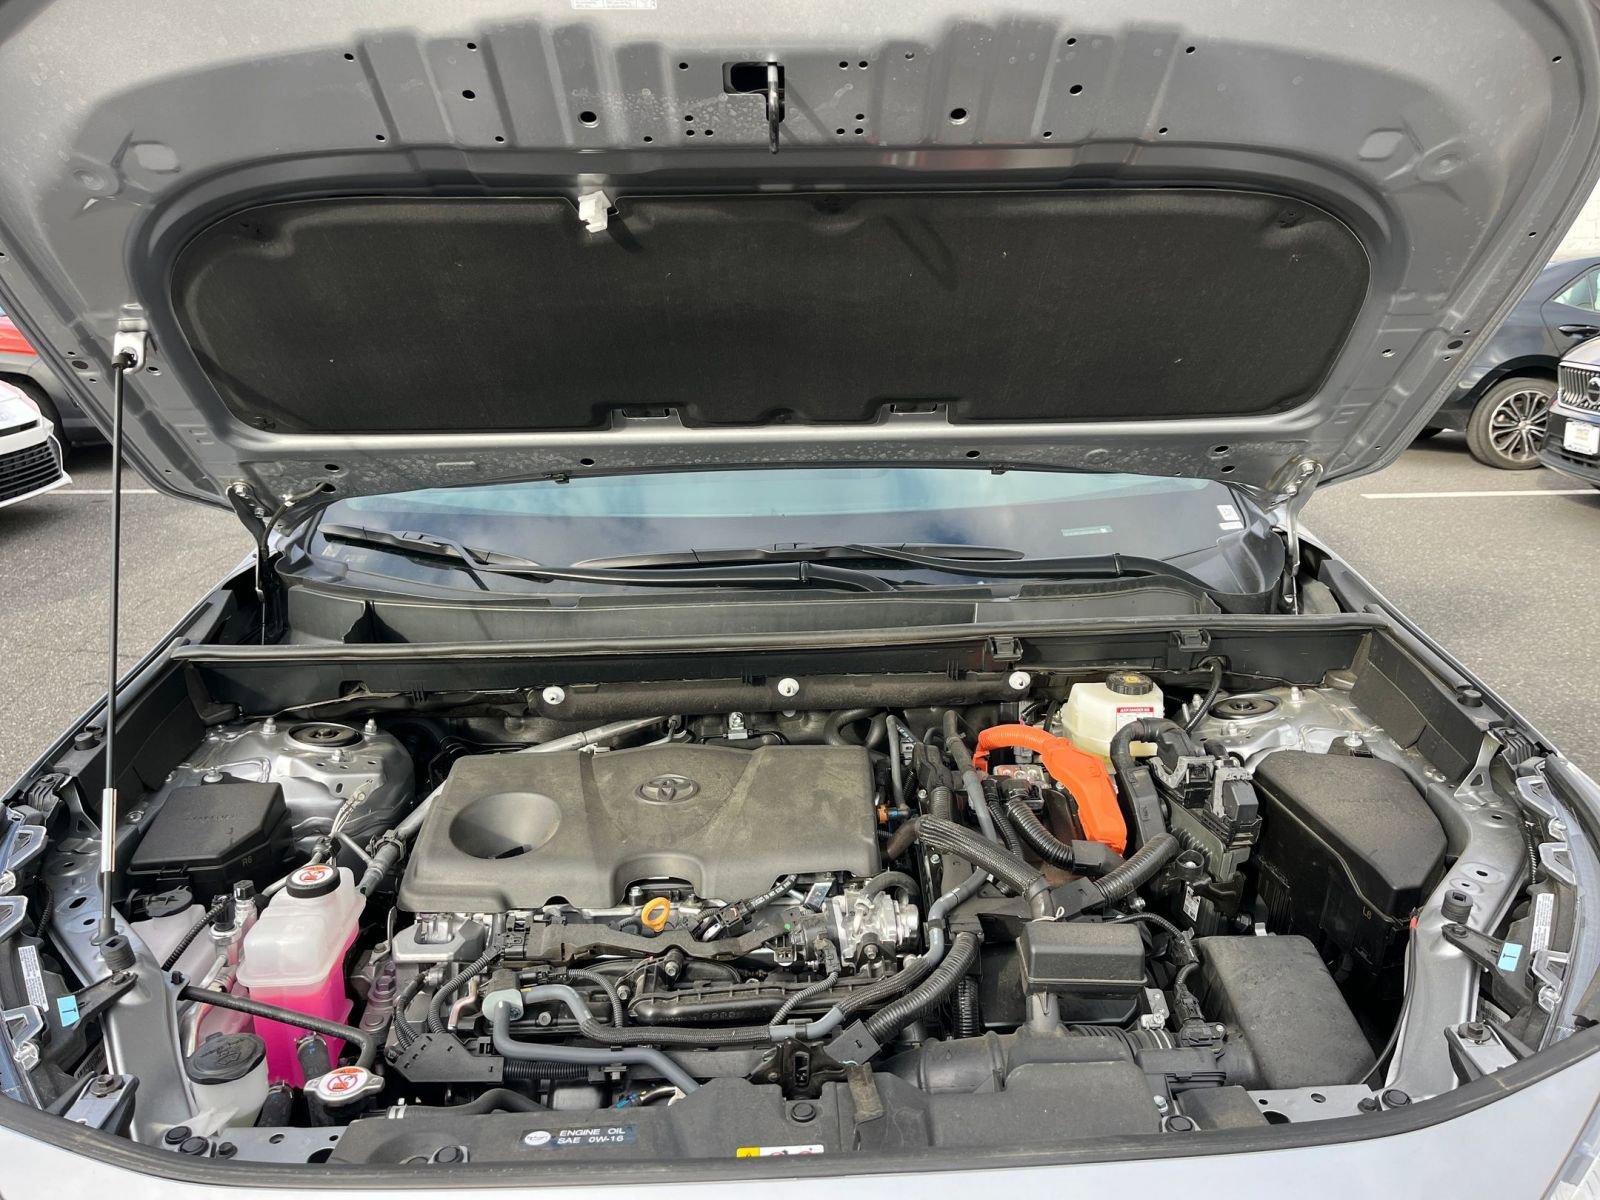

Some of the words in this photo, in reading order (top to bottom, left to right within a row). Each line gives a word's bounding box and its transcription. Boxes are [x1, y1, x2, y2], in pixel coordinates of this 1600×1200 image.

[559, 1128, 601, 1137] ENGINE
[607, 1127, 626, 1135] OIL
[557, 1137, 582, 1145] SAE
[588, 1135, 625, 1143] 0W-16
